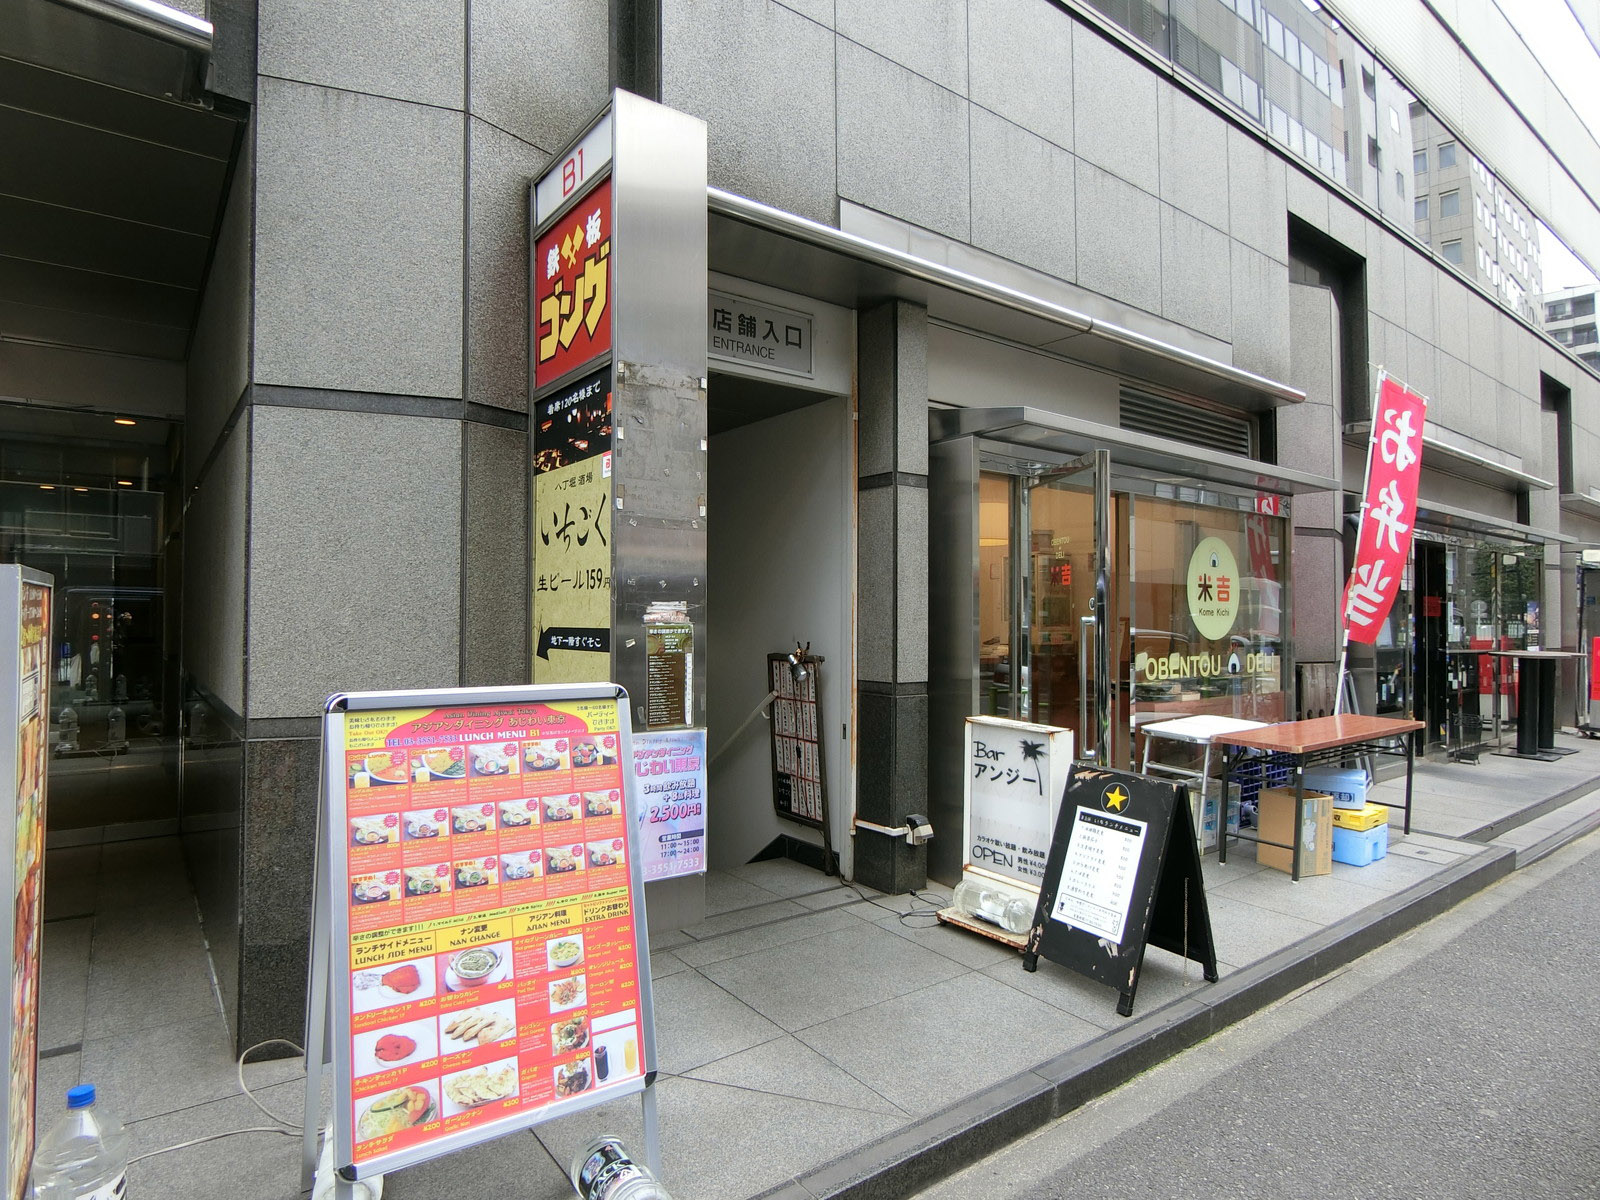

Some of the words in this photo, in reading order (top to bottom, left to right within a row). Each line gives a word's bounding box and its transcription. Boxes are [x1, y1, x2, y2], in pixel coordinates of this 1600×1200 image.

[562, 147, 584, 198] B1
[538, 239, 611, 363] ゴング
[712, 308, 802, 349] 店舗入口
[713, 335, 775, 361] ENTRANCE
[546, 379, 602, 417] 着席120名様まで
[554, 474, 577, 492] 八丁堀
[578, 472, 593, 487] 酒場
[1345, 408, 1417, 627] お弁当
[536, 568, 611, 593] 生ビール159円
[1197, 573, 1231, 603] 米吉
[1198, 608, 1215, 617] Kome
[1216, 608, 1230, 617] Kichi
[550, 634, 602, 649] 地下一階すぐそこ
[1145, 654, 1221, 681] OBENTOU
[1246, 652, 1275, 674] DELI
[443, 711, 465, 719] Asian
[466, 710, 491, 718] Dining
[517, 707, 538, 715] Tokyo
[411, 716, 504, 734] アジアンダイニング
[509, 715, 566, 727] あじわい東京
[387, 738, 403, 748] TEL
[458, 731, 495, 743] LUNCH
[497, 729, 527, 740] MENU
[529, 729, 541, 738] B1
[349, 754, 367, 762] Quick
[367, 752, 388, 760] Lunch
[429, 748, 448, 756] Lunch
[973, 741, 1005, 763] Bar
[635, 757, 701, 778] じわい東京
[974, 762, 1037, 786] アンジー
[643, 778, 697, 795] 3時間飲み放題
[661, 833, 682, 843] 営業時間
[972, 844, 1013, 868] OPEN
[1017, 856, 1029, 866] 男性
[1017, 865, 1028, 874] 女性
[526, 922, 548, 933] ASIAN
[550, 917, 571, 928] MENU
[529, 909, 567, 923] アジアン料理
[584, 912, 606, 924] EXTRA
[607, 909, 629, 920] DRINK
[460, 923, 488, 936] ナン変更
[355, 936, 432, 956] ランチサイドメニュー
[449, 937, 468, 948] NAN
[469, 931, 501, 945] CHANGE
[354, 953, 385, 966] LUNCH
[386, 950, 406, 960] SIDE
[408, 946, 433, 958] MENU
[590, 1000, 610, 1008] コーヒー
[354, 1083, 378, 1094] Chicken
[355, 1135, 394, 1152] ランチサラダ
[355, 1148, 373, 1159] Lunch
